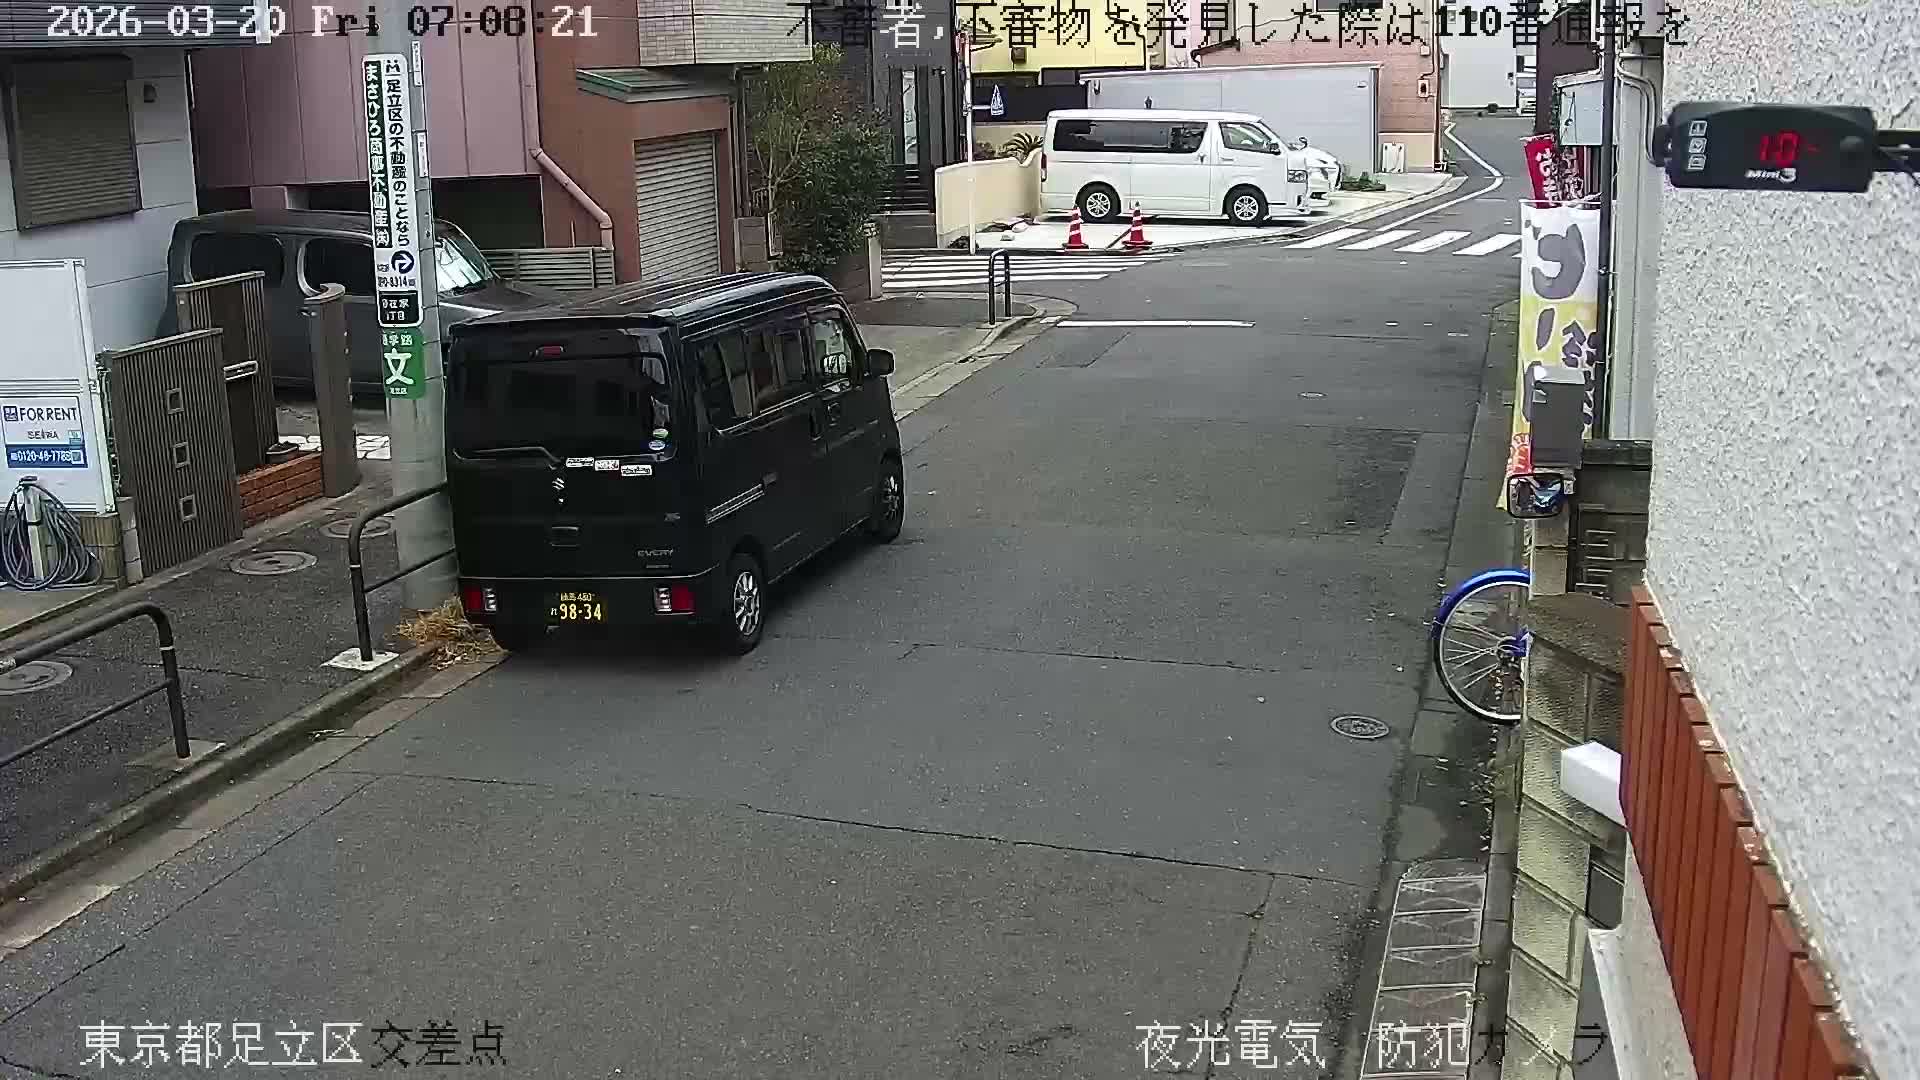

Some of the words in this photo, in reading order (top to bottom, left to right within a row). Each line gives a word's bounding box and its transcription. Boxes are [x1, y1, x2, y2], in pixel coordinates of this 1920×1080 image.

[383, 347, 414, 385] 文
[19, 407, 45, 421] FOR
[46, 407, 77, 421] RENT
